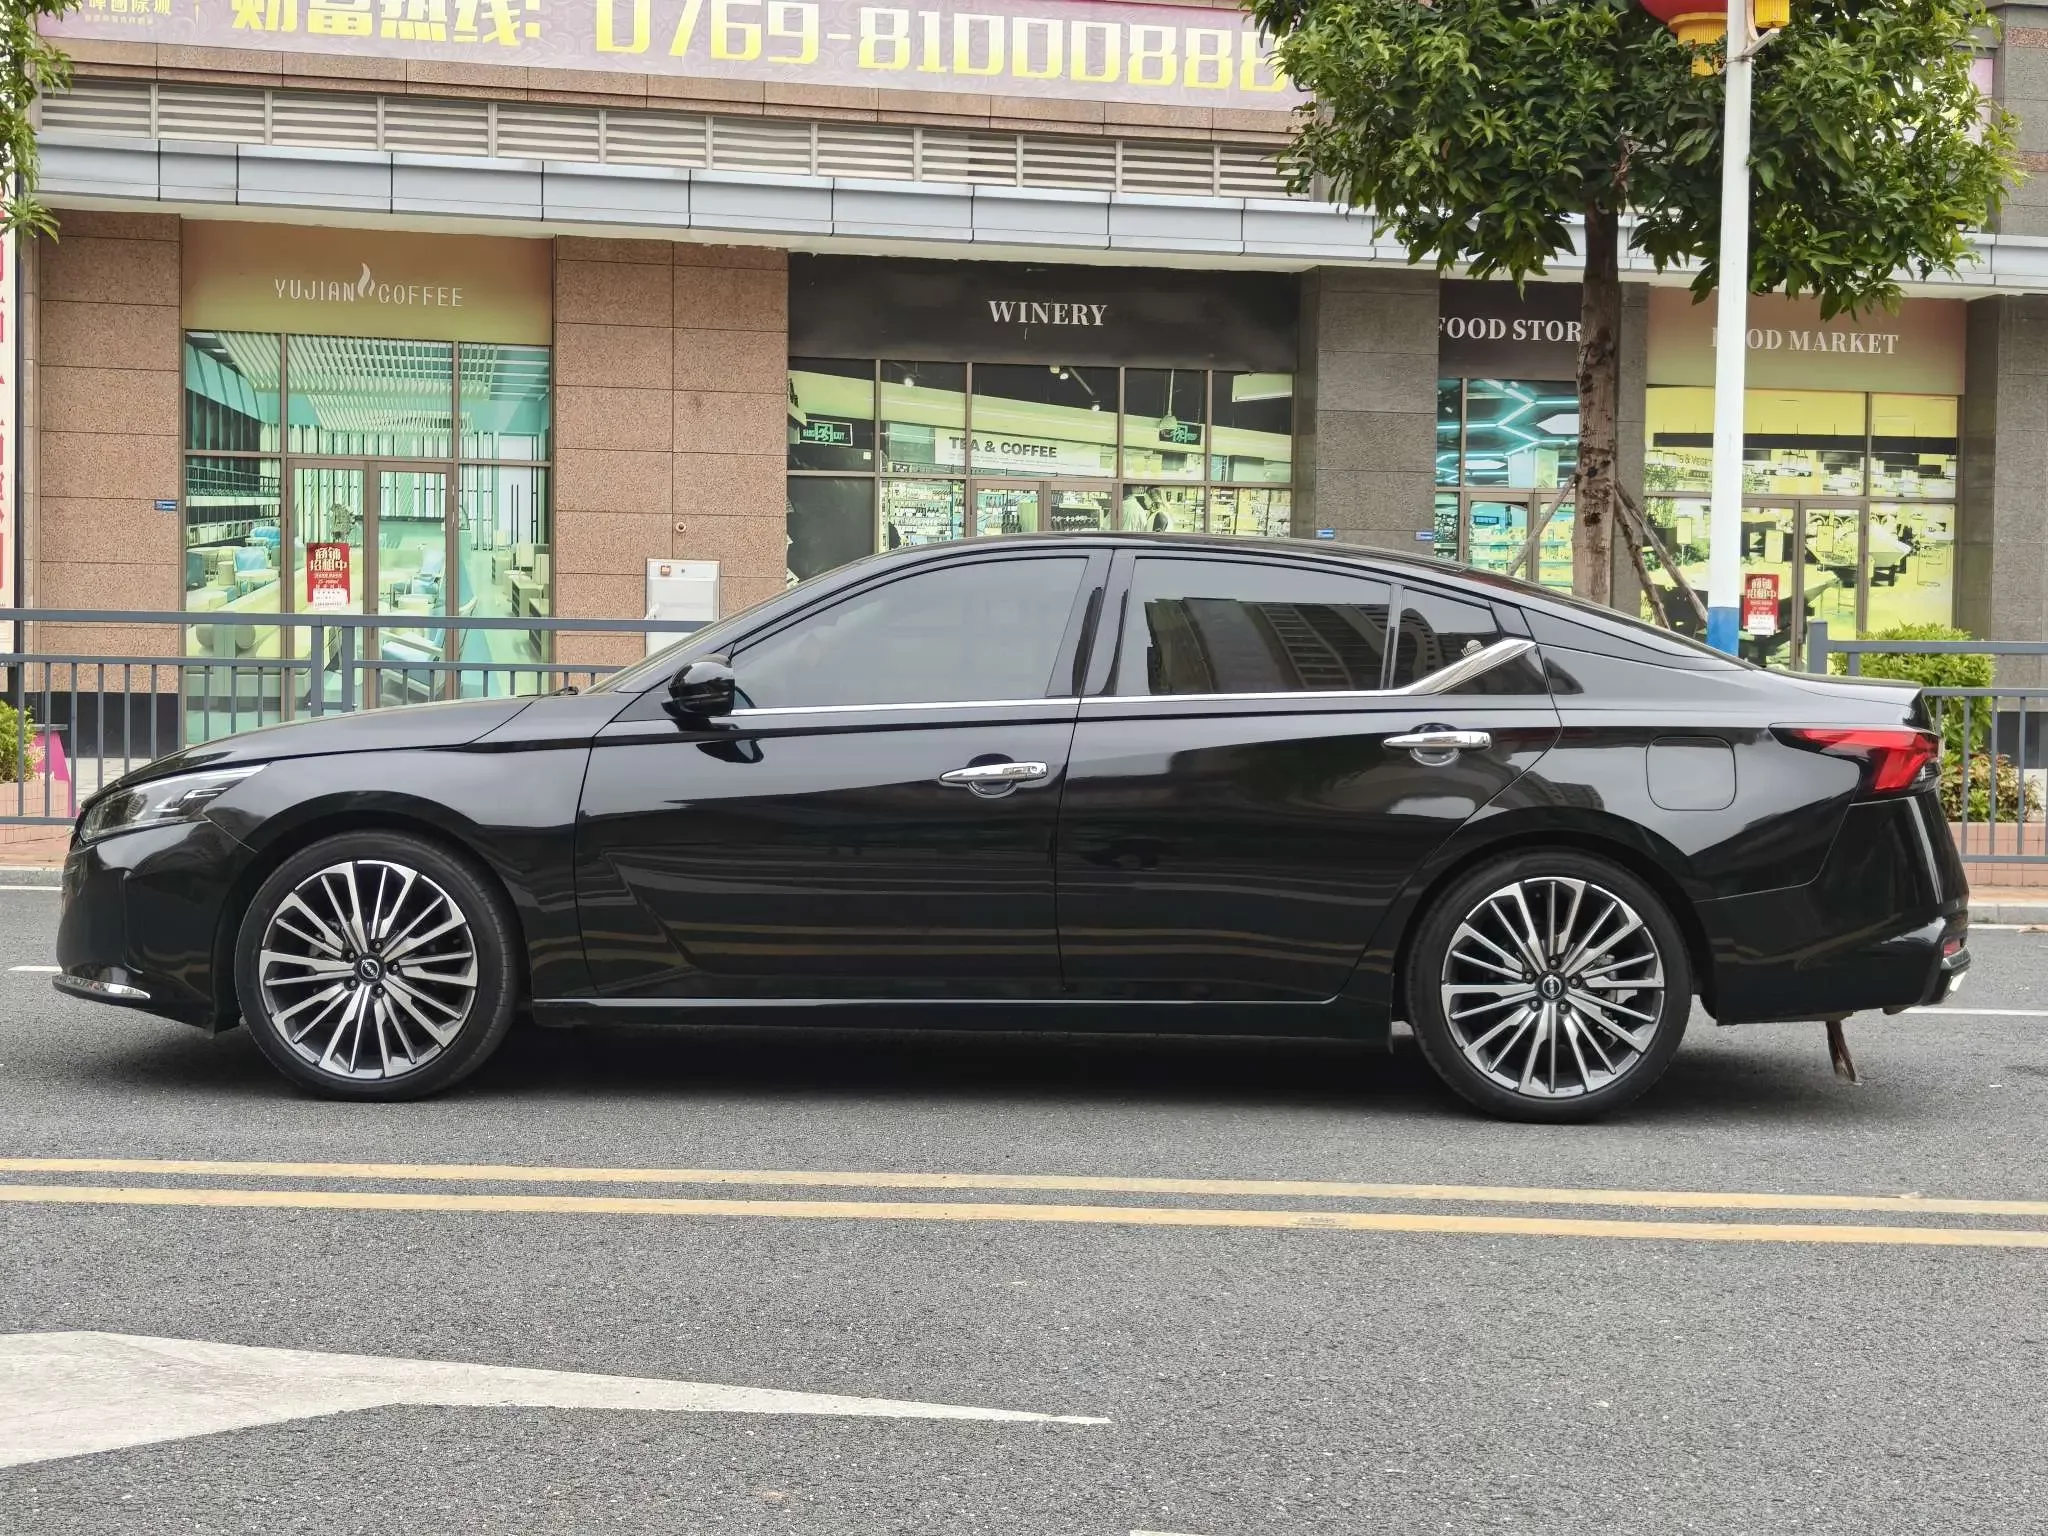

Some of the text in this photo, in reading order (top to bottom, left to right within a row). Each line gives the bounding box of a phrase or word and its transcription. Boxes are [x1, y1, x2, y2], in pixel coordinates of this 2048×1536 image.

[595, 0, 1290, 92] 0769-81000888
[274, 278, 464, 307] YUJIAN COFFEE
[987, 300, 1108, 326] WINERY
[1711, 328, 1900, 354] OD MARKET
[949, 436, 1058, 458] TEA & COFFEE
